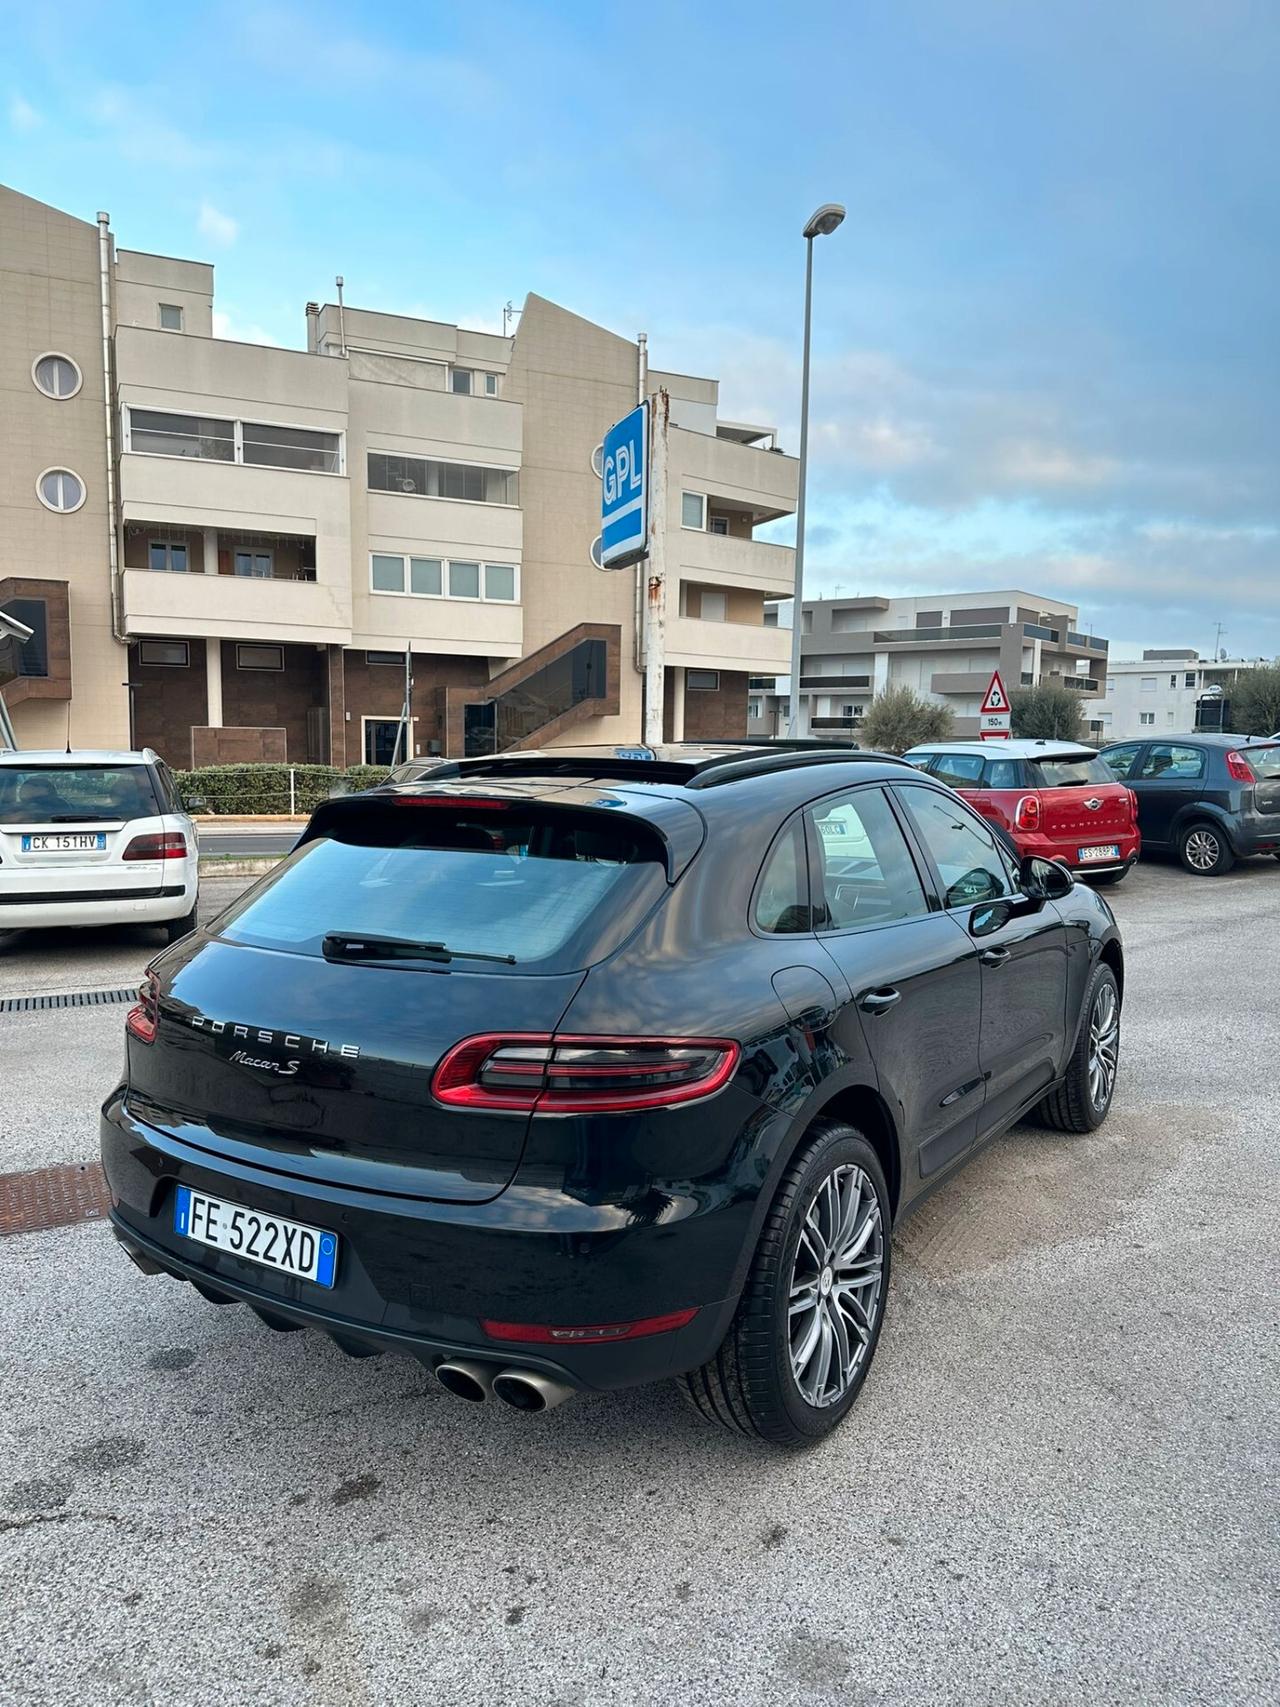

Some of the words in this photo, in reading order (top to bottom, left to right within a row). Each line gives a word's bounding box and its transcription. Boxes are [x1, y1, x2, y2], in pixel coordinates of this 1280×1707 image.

[604, 440, 642, 505] GPL
[32, 835, 49, 849] CK
[56, 835, 96, 849] 151HV
[191, 1015, 361, 1058] PORSCHE
[229, 1050, 279, 1073] Macan
[278, 1060, 300, 1075] S
[191, 1196, 221, 1243] FE
[229, 1210, 316, 1274] 522XD
